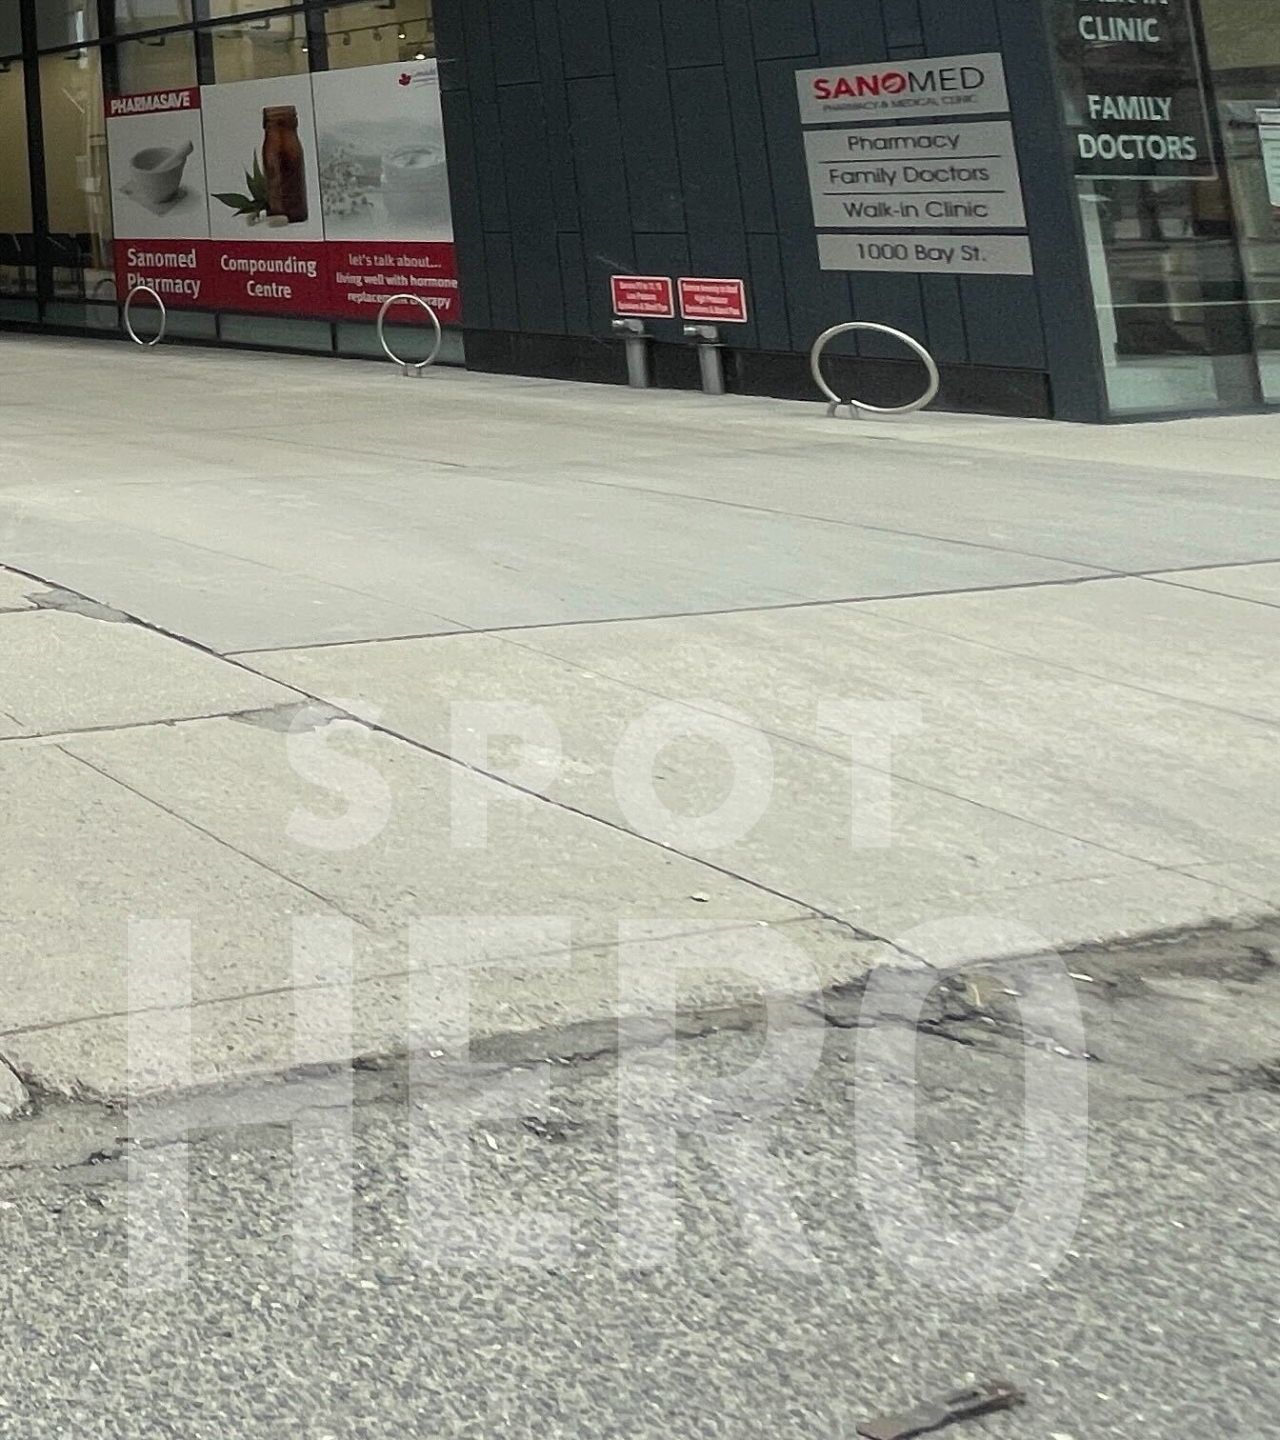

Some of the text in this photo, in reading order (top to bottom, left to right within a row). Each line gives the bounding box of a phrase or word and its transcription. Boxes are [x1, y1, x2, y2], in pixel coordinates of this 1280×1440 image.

[1078, 16, 1161, 42] CLINIC
[813, 67, 984, 100] SANOMED
[110, 91, 190, 114] PHARMASAVE
[1087, 95, 1172, 121] FAMILY
[848, 134, 960, 152] Pharmacy
[1077, 134, 1197, 160] DOCTORS
[829, 166, 989, 187] Family Doctors
[843, 200, 988, 218] Walk-in Clinic
[127, 248, 197, 269] Sanomed
[349, 253, 372, 266] let's
[374, 253, 396, 267] talk
[857, 243, 986, 264] 1000 Bay St.
[221, 254, 317, 278] Compounding
[127, 273, 200, 299] Pharmacy
[247, 280, 291, 298] Centre
[385, 274, 408, 286] with
[410, 275, 458, 288] hormone
